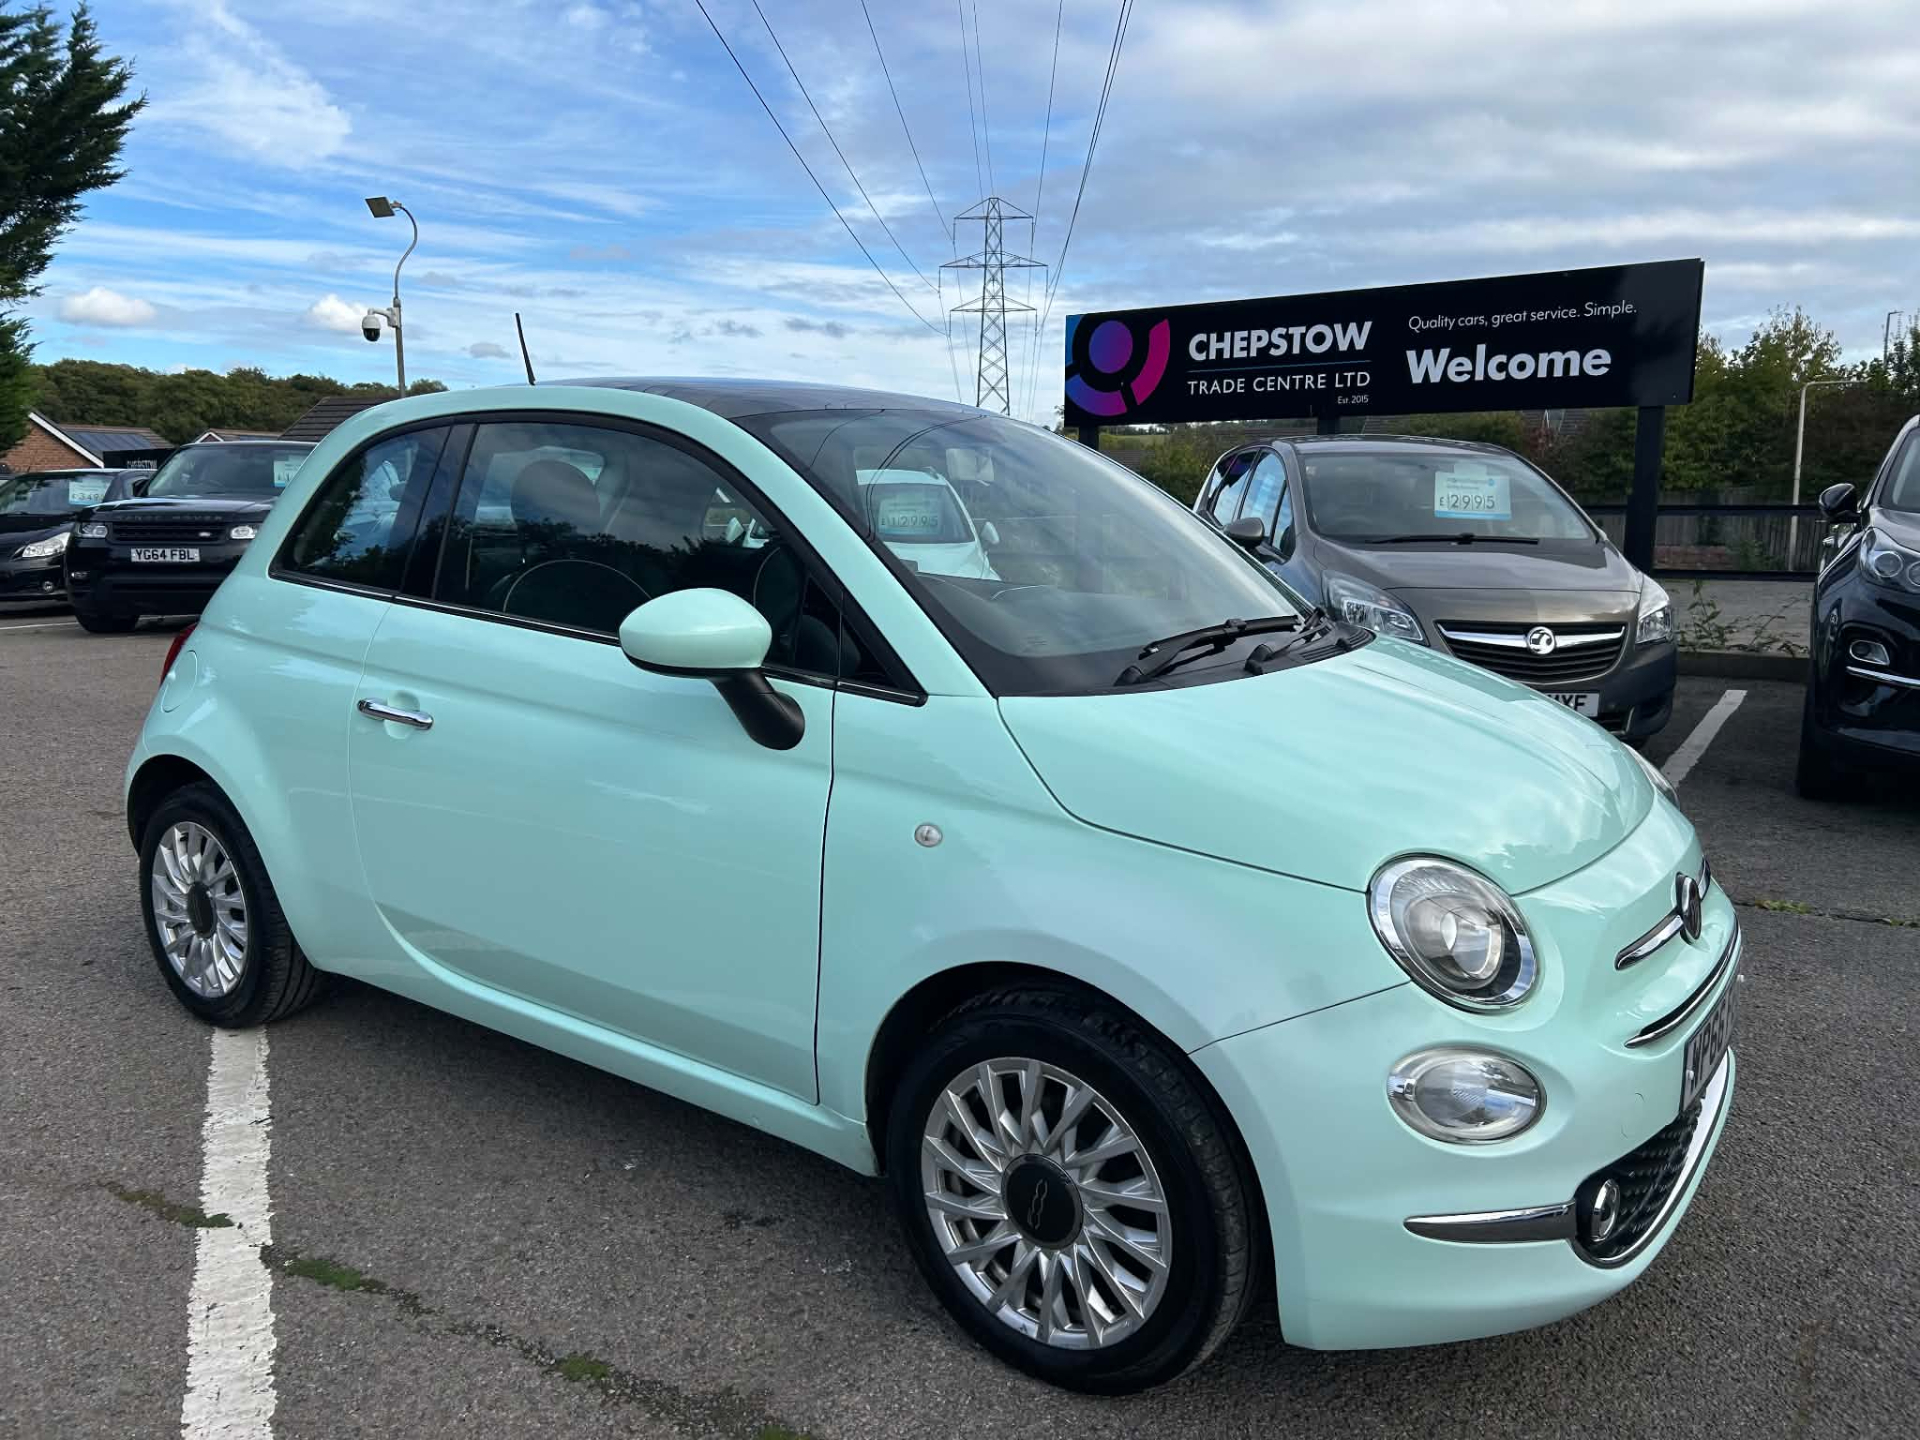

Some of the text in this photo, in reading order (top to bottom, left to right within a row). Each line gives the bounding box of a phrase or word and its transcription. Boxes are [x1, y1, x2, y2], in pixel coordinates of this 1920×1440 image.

[1408, 300, 1637, 333] Quality cars, great service. Simple.
[1188, 321, 1373, 361] CHEPSTOW
[1406, 343, 1612, 384] Welcome
[1187, 372, 1371, 395] TRADE CENTRE LTD
[1337, 395, 1369, 404] Est. 2015
[135, 549, 195, 560] YG64 FBL
